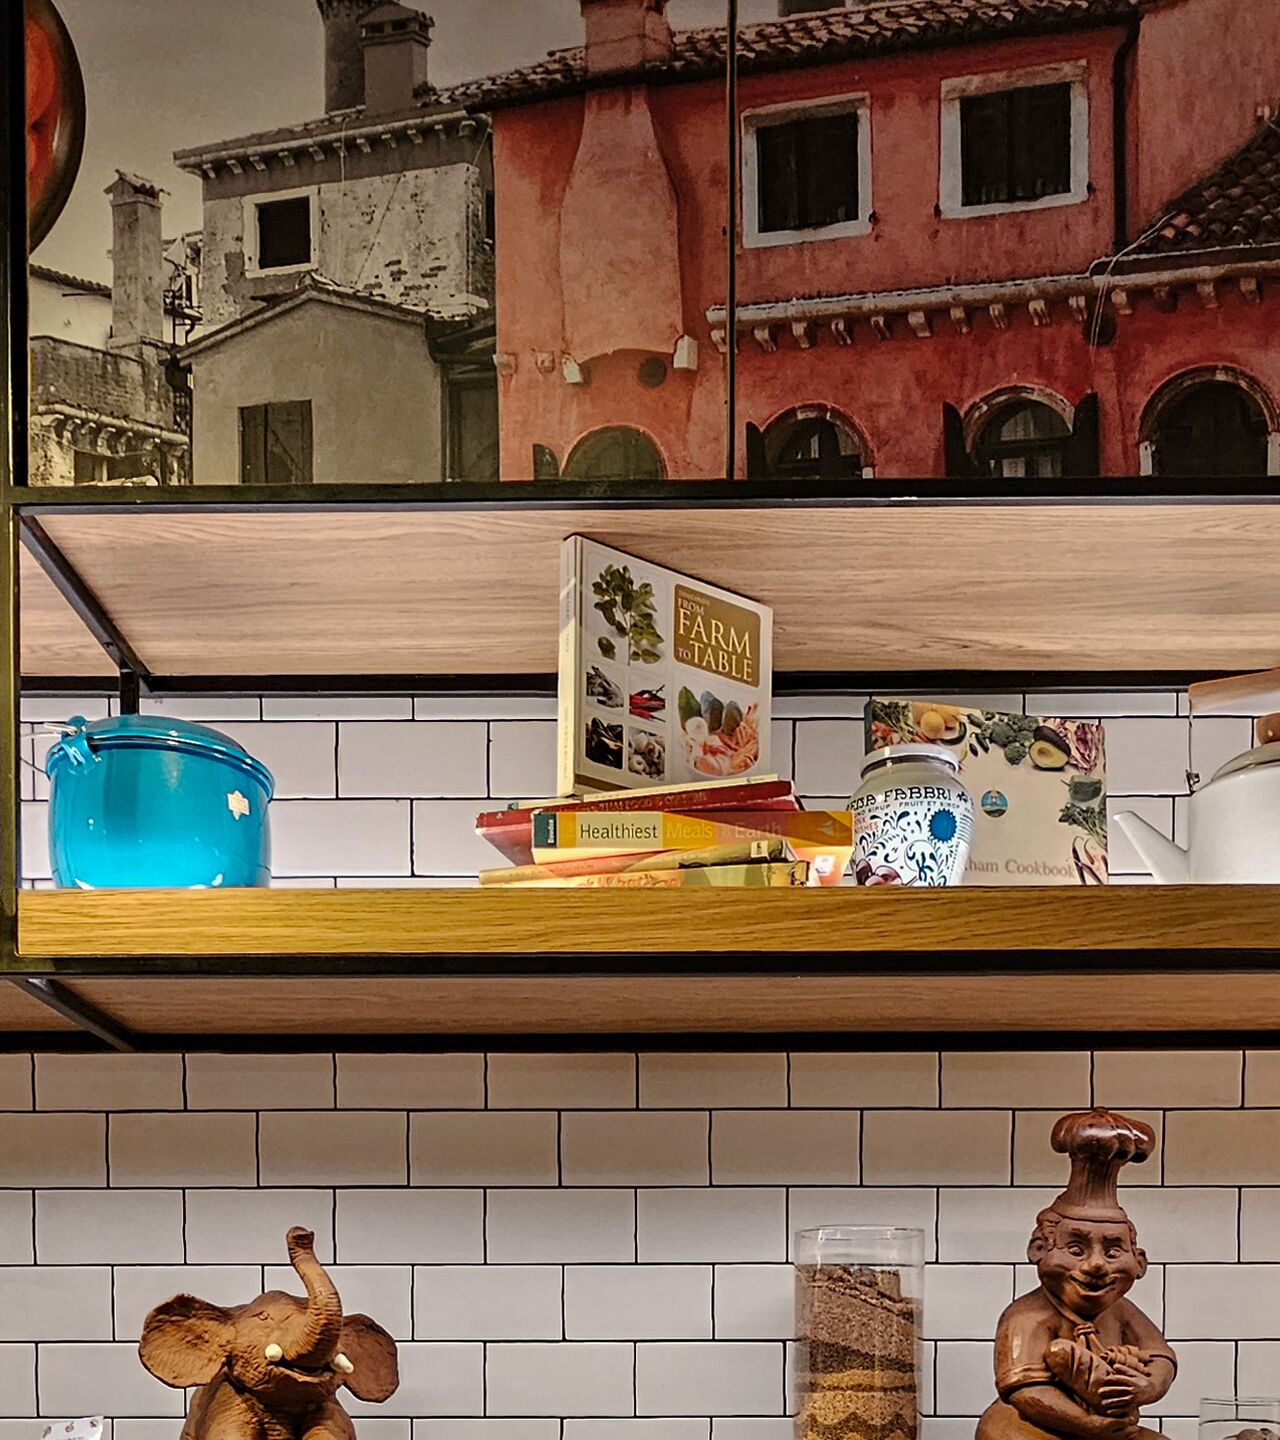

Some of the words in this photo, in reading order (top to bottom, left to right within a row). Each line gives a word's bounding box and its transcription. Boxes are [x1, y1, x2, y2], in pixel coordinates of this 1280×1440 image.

[678, 598, 704, 615] FROM
[678, 608, 752, 658] FARM
[678, 647, 691, 660] TO
[689, 640, 752, 681] TABLE
[884, 787, 951, 802] FABBRI
[580, 823, 658, 839] Healthiest
[666, 823, 713, 838] Meals
[735, 822, 781, 838] Earth
[965, 857, 999, 873] ham
[1005, 859, 1075, 878] Cookbook
